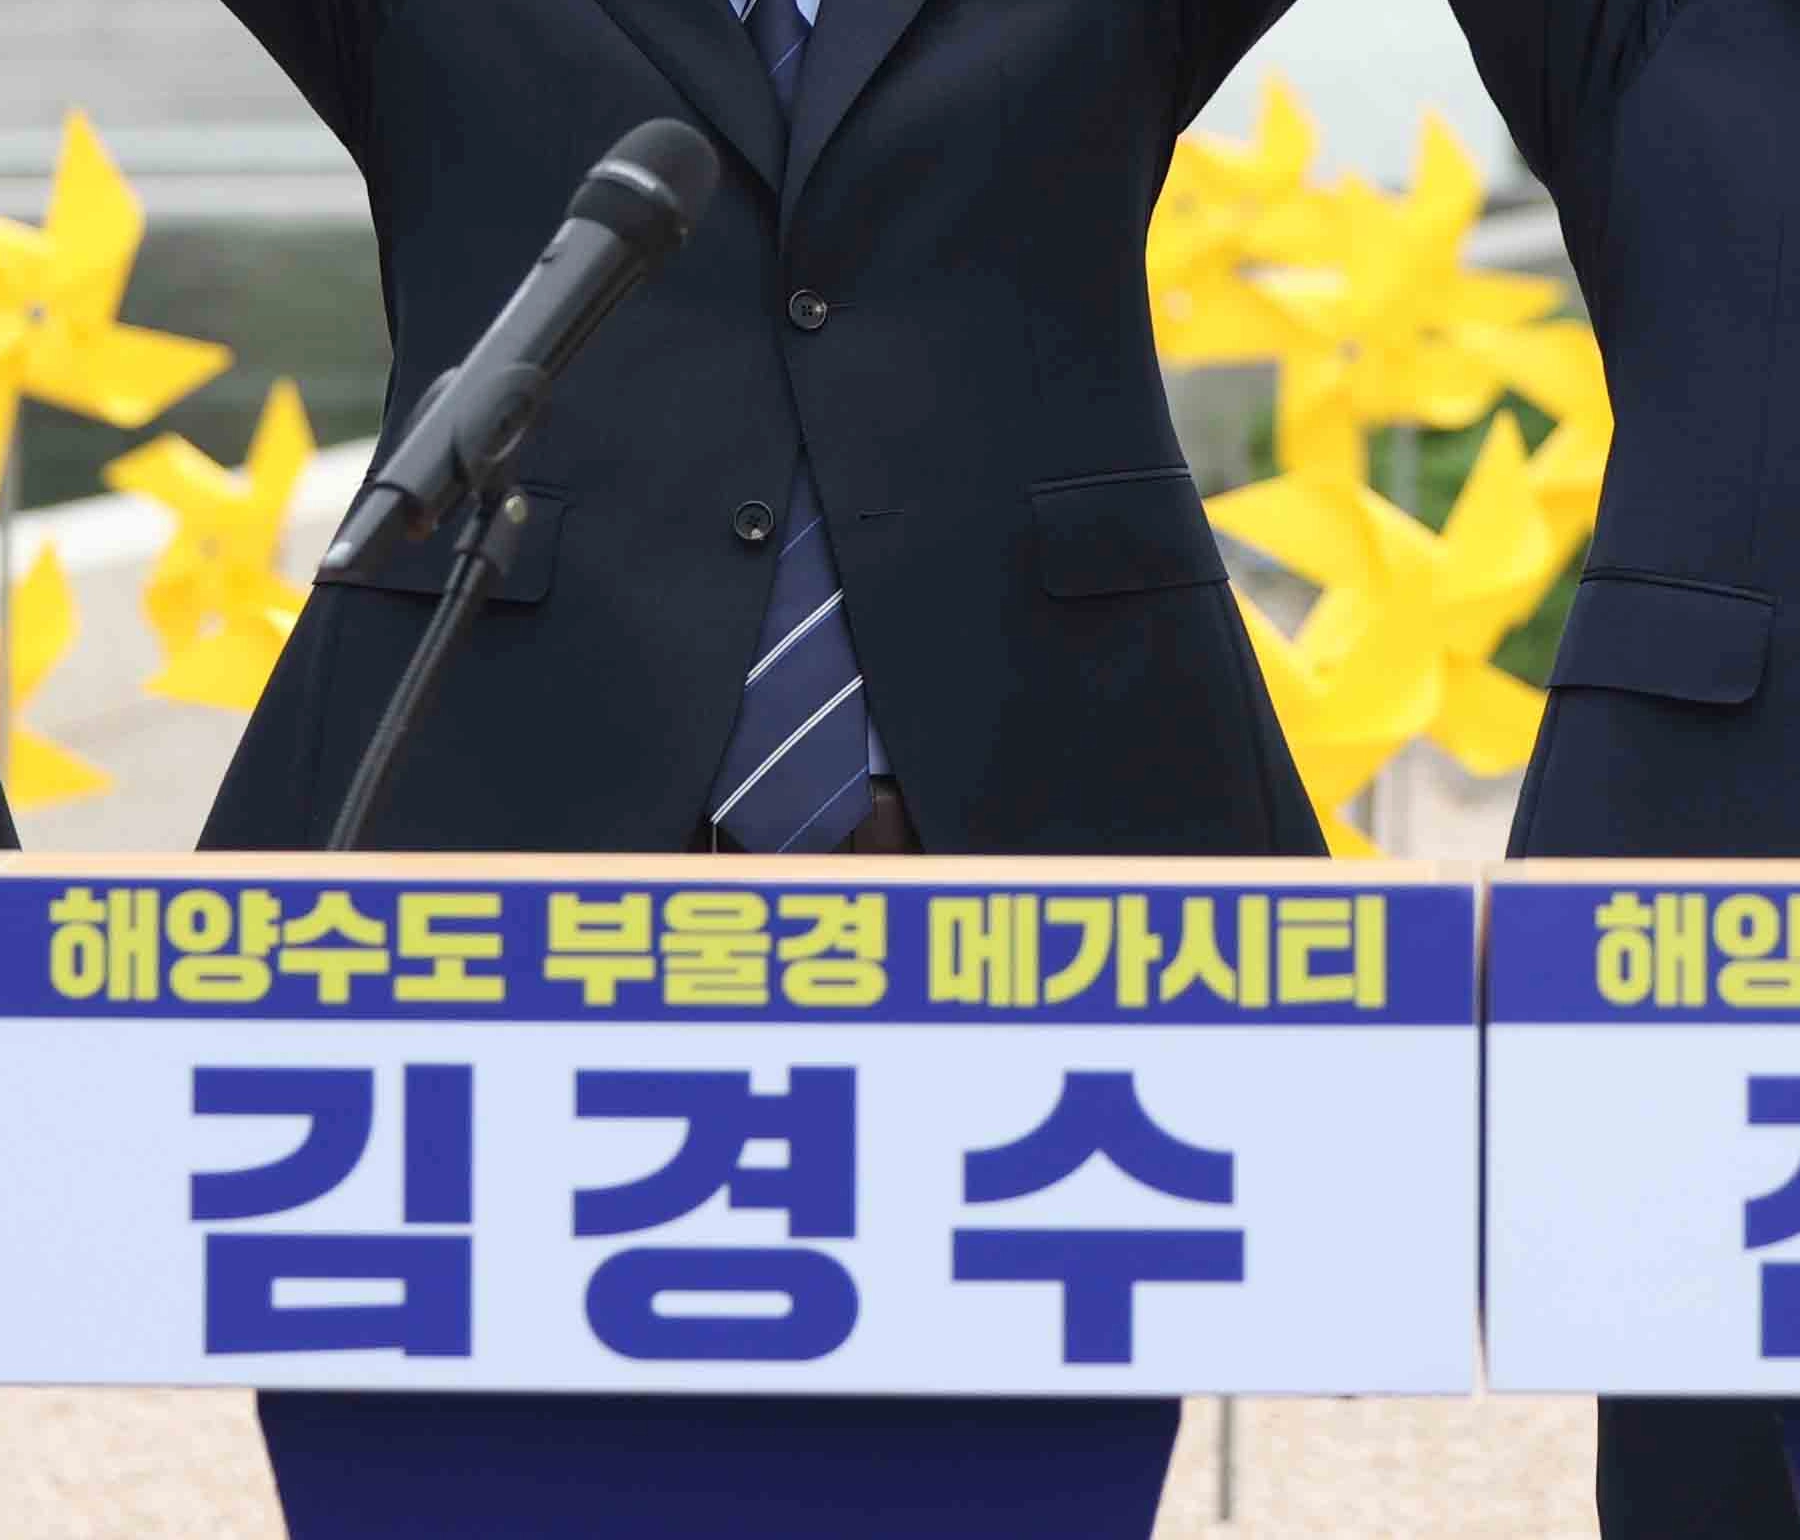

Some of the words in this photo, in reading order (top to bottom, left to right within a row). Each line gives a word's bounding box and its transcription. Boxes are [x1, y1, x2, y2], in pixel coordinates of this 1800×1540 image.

[51, 889, 504, 1002] 해양수도
[546, 893, 885, 1005] 부울경
[930, 895, 1384, 1007] 메가시티
[192, 1065, 1243, 1363] 김경수
